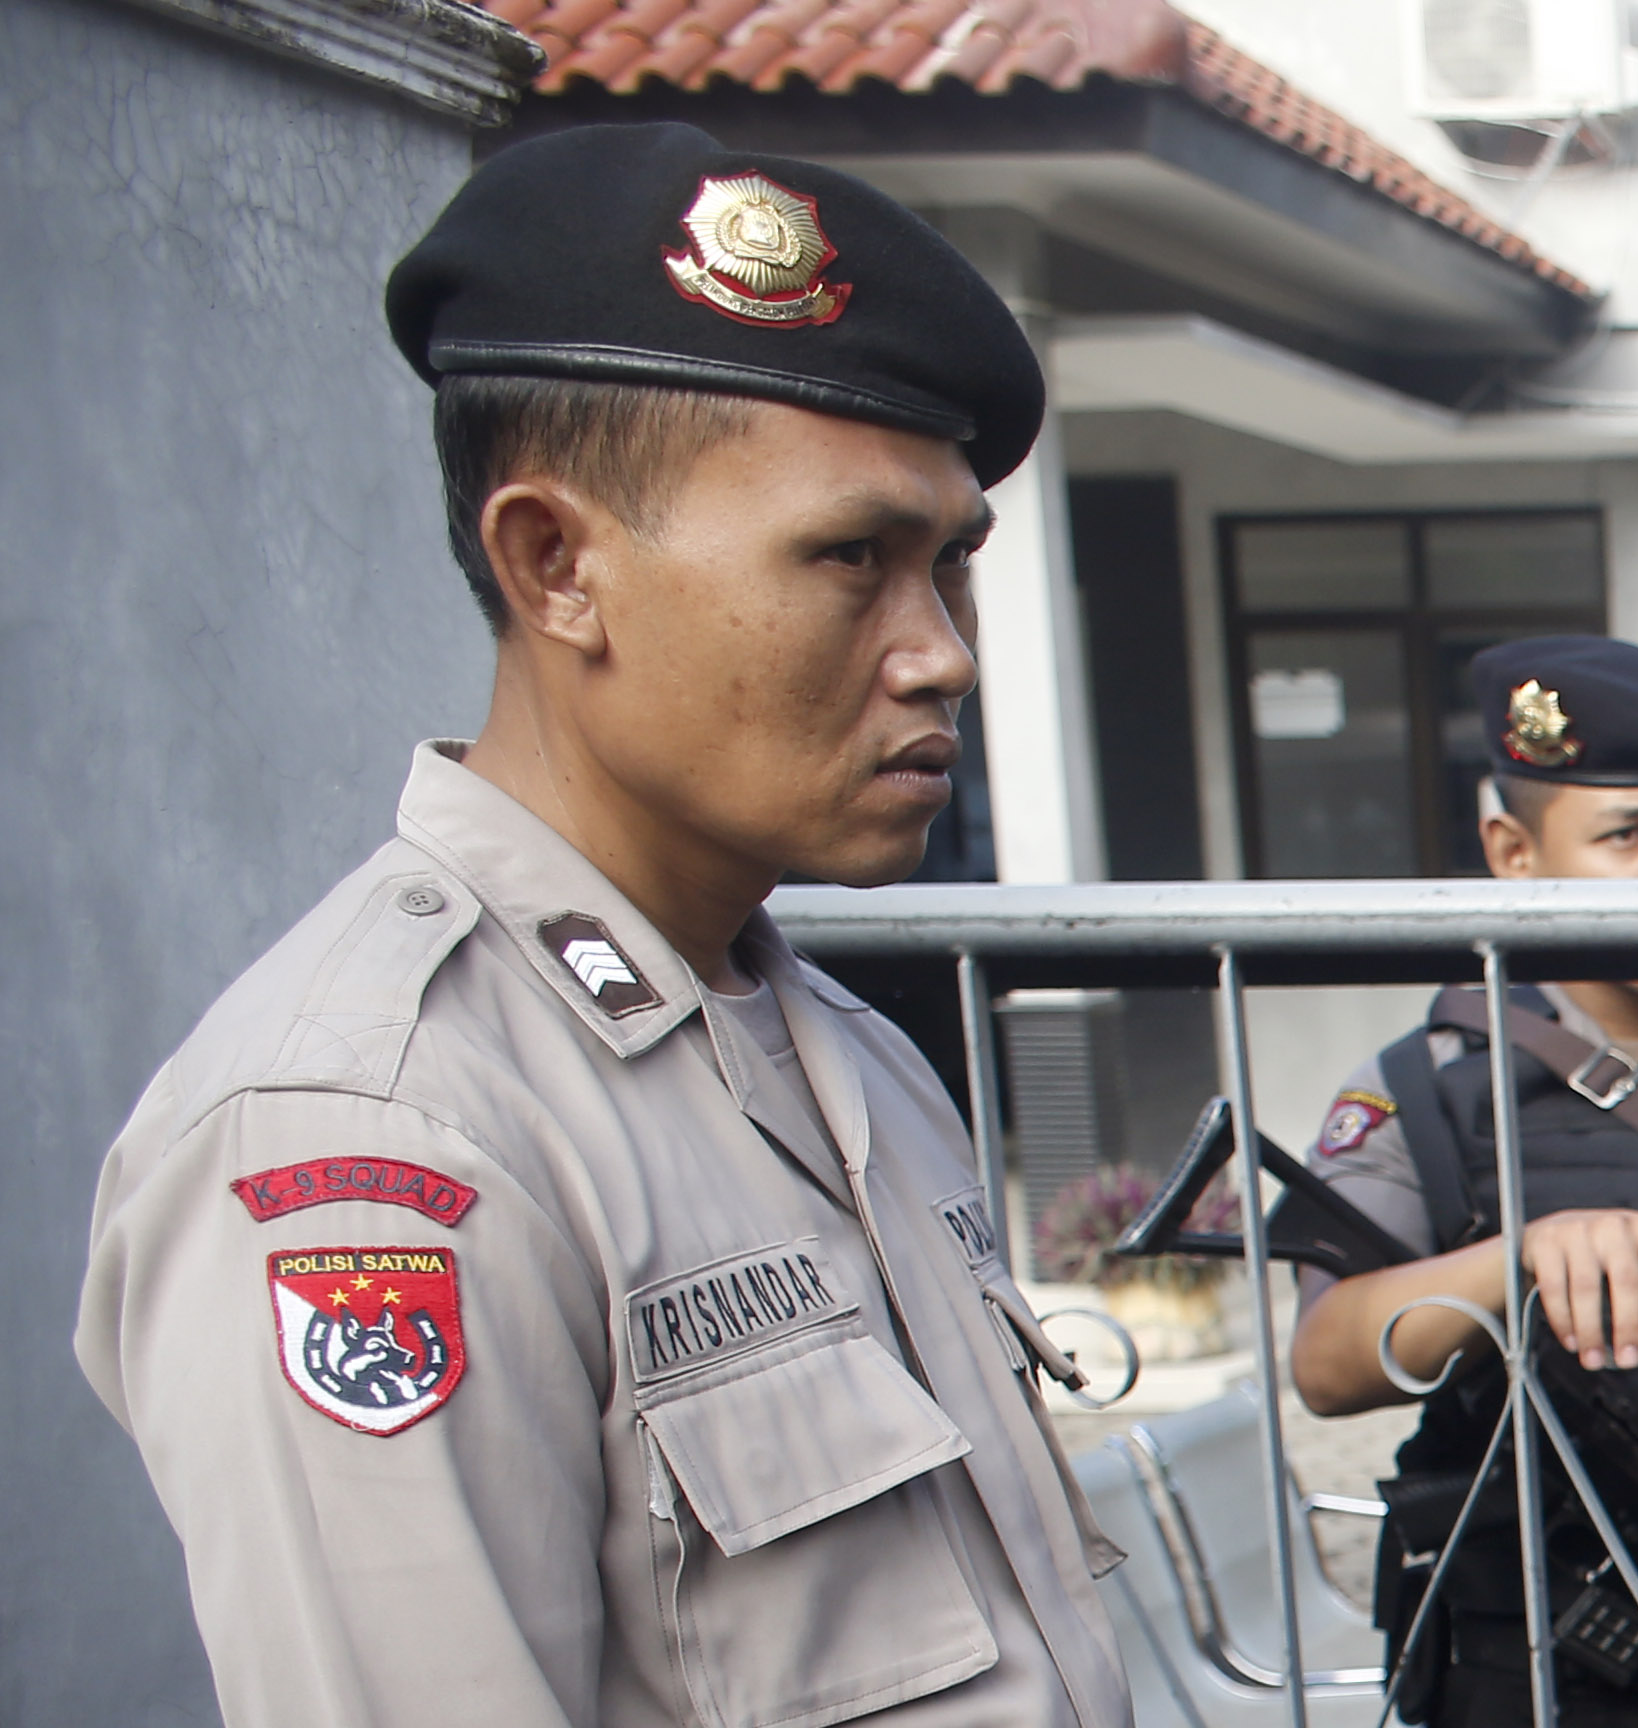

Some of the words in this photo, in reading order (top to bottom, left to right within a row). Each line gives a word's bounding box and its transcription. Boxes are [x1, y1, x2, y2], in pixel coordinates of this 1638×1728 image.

[250, 1170, 316, 1209] K-9
[325, 1163, 457, 1213] SQUAD
[279, 1255, 354, 1276] POLISI
[363, 1254, 446, 1273] SATWA
[640, 1252, 836, 1369] KRISNANDAR
